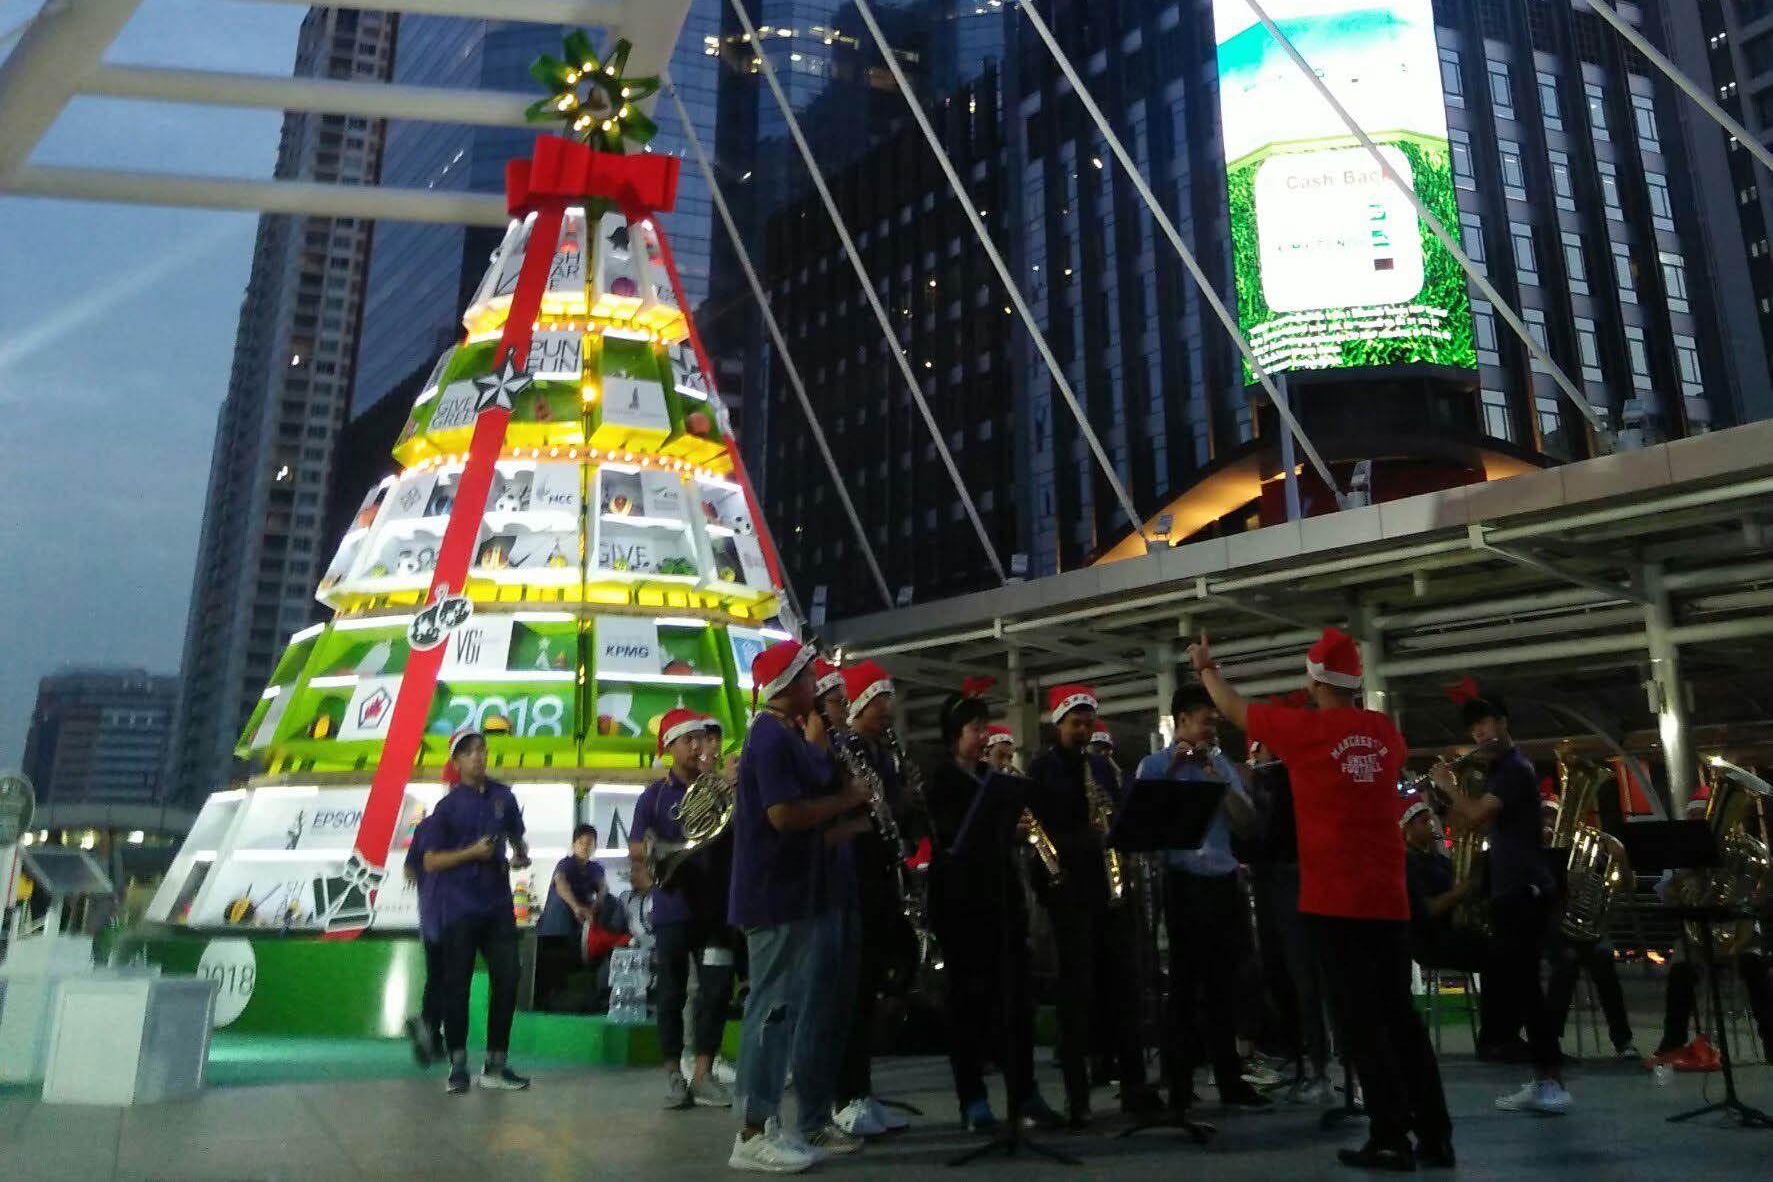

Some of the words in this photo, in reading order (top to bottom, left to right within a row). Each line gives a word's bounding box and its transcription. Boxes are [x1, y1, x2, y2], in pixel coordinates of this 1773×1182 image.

[1286, 173, 1334, 190] Cash
[1343, 170, 1384, 185] Bac
[605, 644, 650, 659] KPMG
[448, 694, 564, 738] 2018
